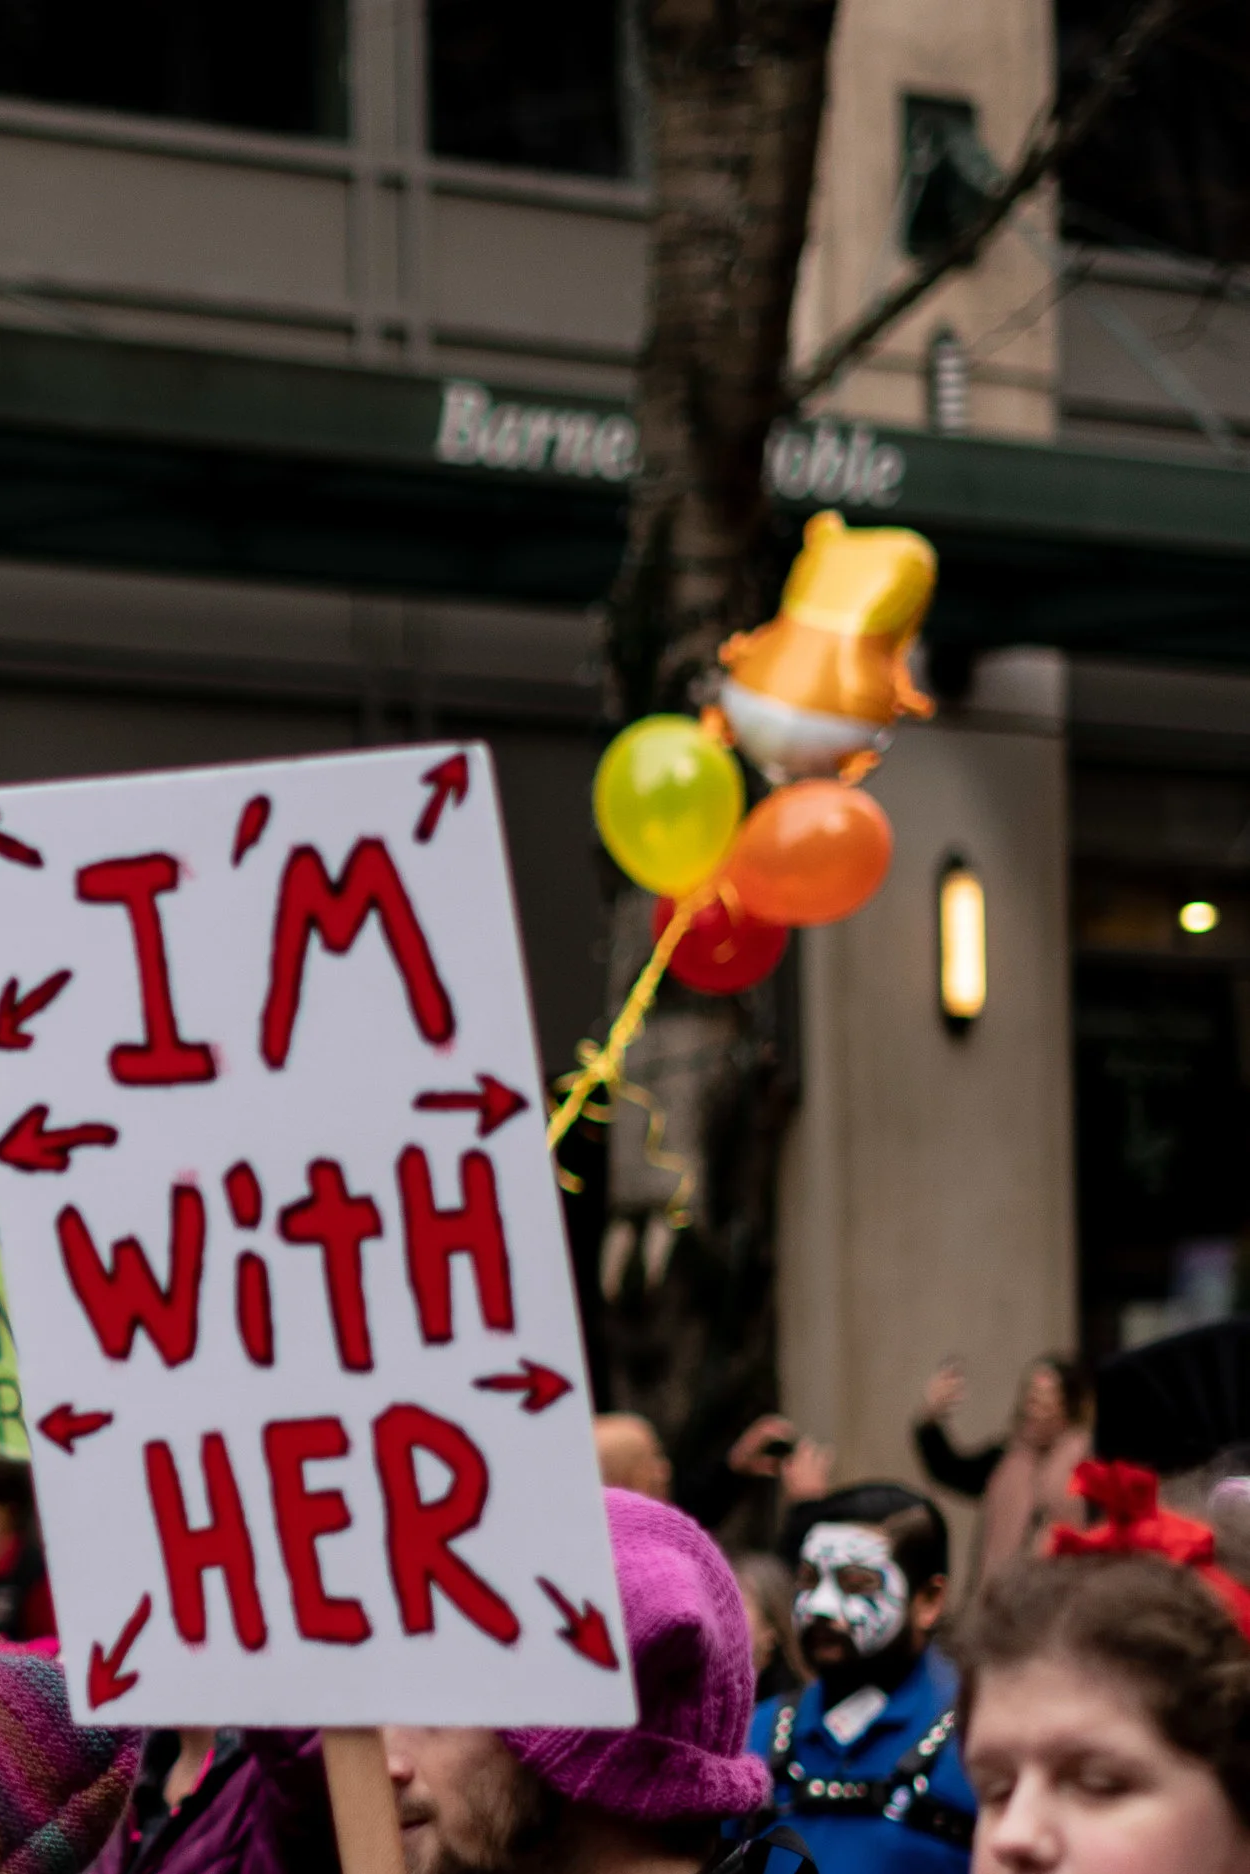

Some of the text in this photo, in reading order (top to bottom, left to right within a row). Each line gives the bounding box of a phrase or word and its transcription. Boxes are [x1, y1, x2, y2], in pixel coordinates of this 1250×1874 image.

[762, 417, 907, 506] oble
[76, 794, 458, 1087] I'M
[144, 1402, 522, 1652] HER
